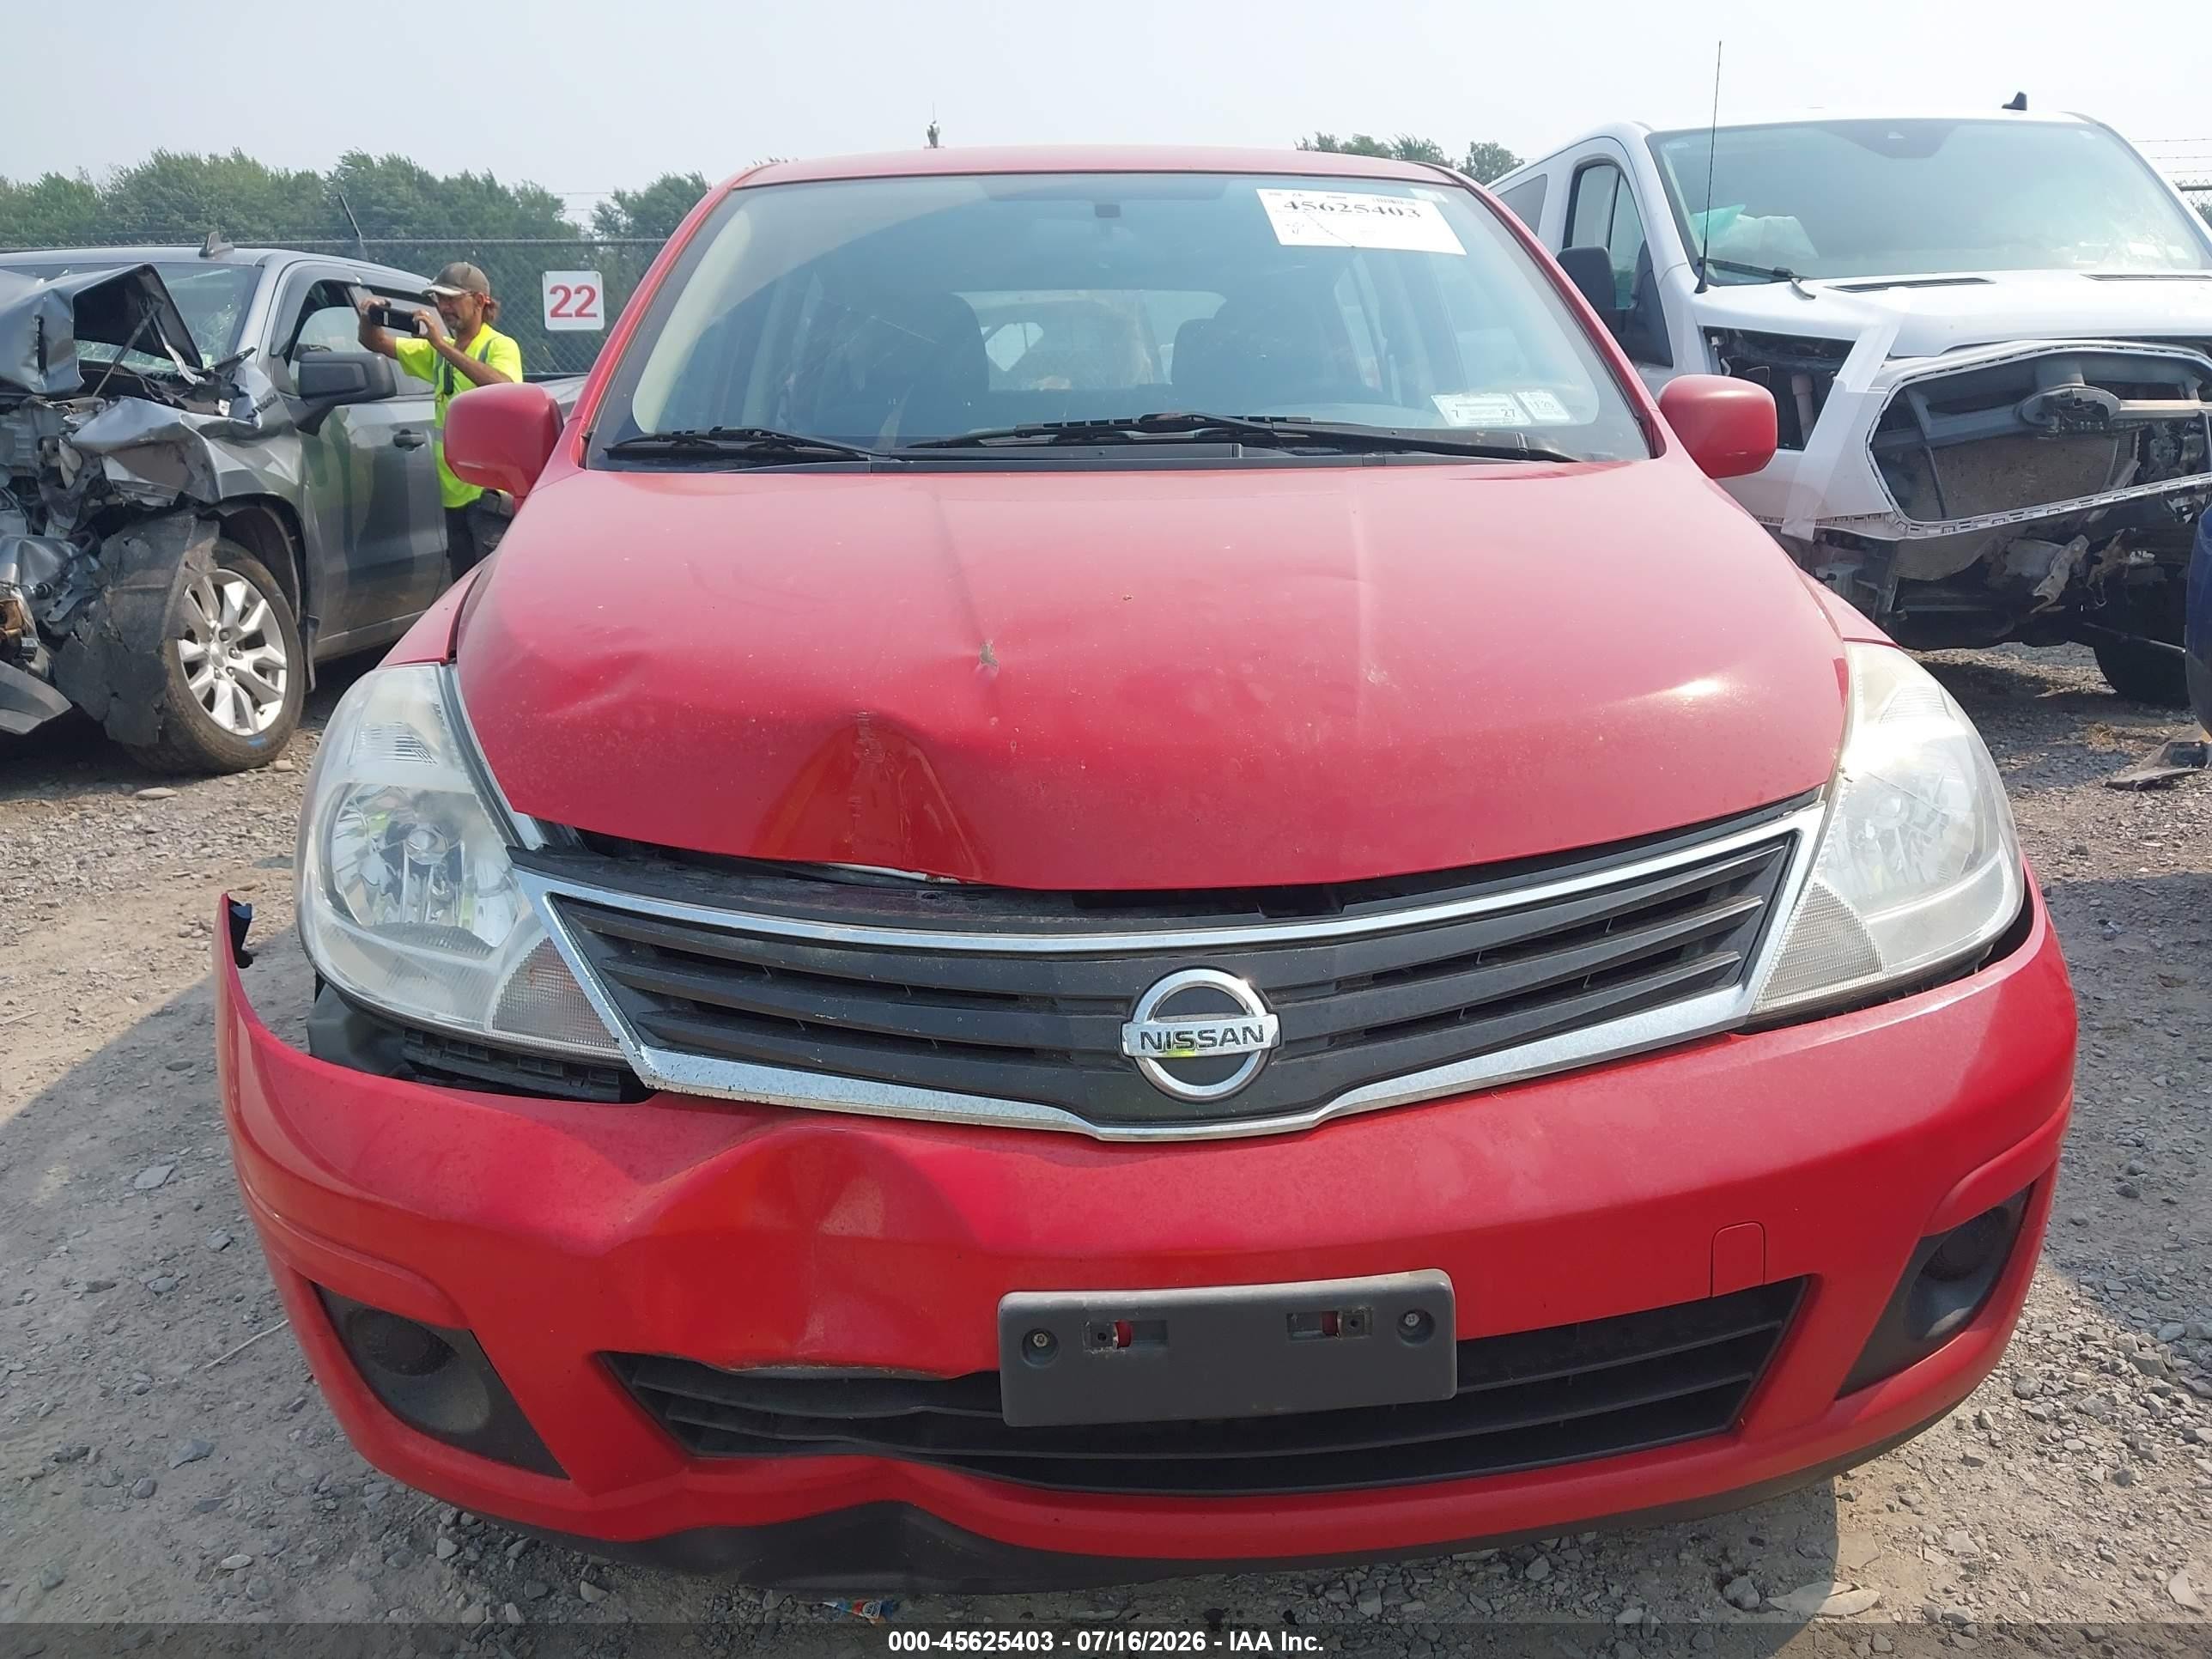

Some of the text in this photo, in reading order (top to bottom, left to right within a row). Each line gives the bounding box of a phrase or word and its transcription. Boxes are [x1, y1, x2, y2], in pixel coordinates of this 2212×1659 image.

[1284, 200, 1422, 219] 45625403
[550, 284, 598, 318] 22
[1139, 1024, 1265, 1051] NISSAN
